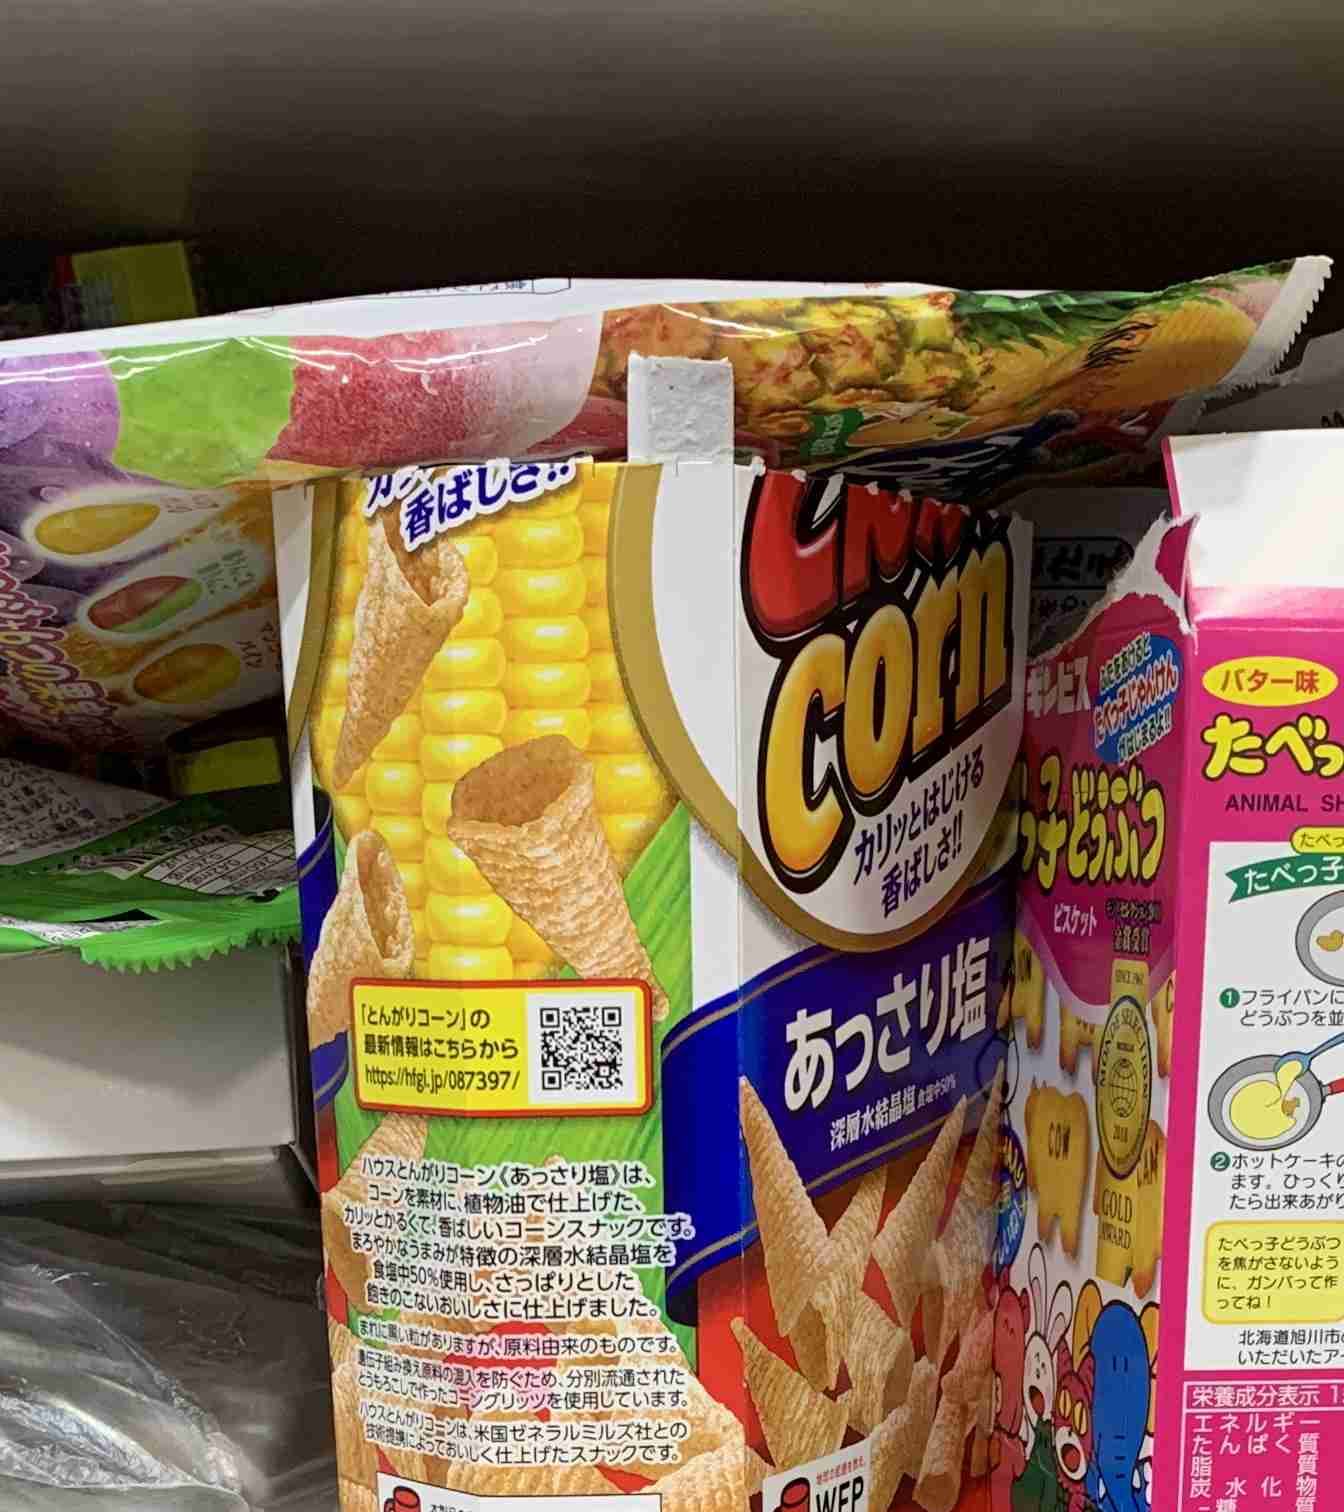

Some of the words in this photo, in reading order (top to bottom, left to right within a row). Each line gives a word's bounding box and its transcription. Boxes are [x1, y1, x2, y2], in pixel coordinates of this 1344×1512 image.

[1220, 669, 1321, 694] バター味
[765, 540, 1007, 873] Corn
[854, 745, 985, 885] カリッとはじける
[1225, 795, 1308, 813] ANIMAL
[1054, 904, 1097, 936] ビスケット
[362, 1004, 490, 1031] 「とんがりコーン」の
[784, 937, 990, 1111] あっさり塩
[364, 1034, 519, 1060] 最新情報はこちらから
[1102, 1188, 1133, 1223] GOLD
[1218, 1235, 1342, 1253] たべっ子どうぶつ
[1217, 1254, 1342, 1272] を焦がさないよう
[1216, 1273, 1338, 1292] に、ガンバって作
[1193, 1385, 1320, 1406] 栄養成分表示
